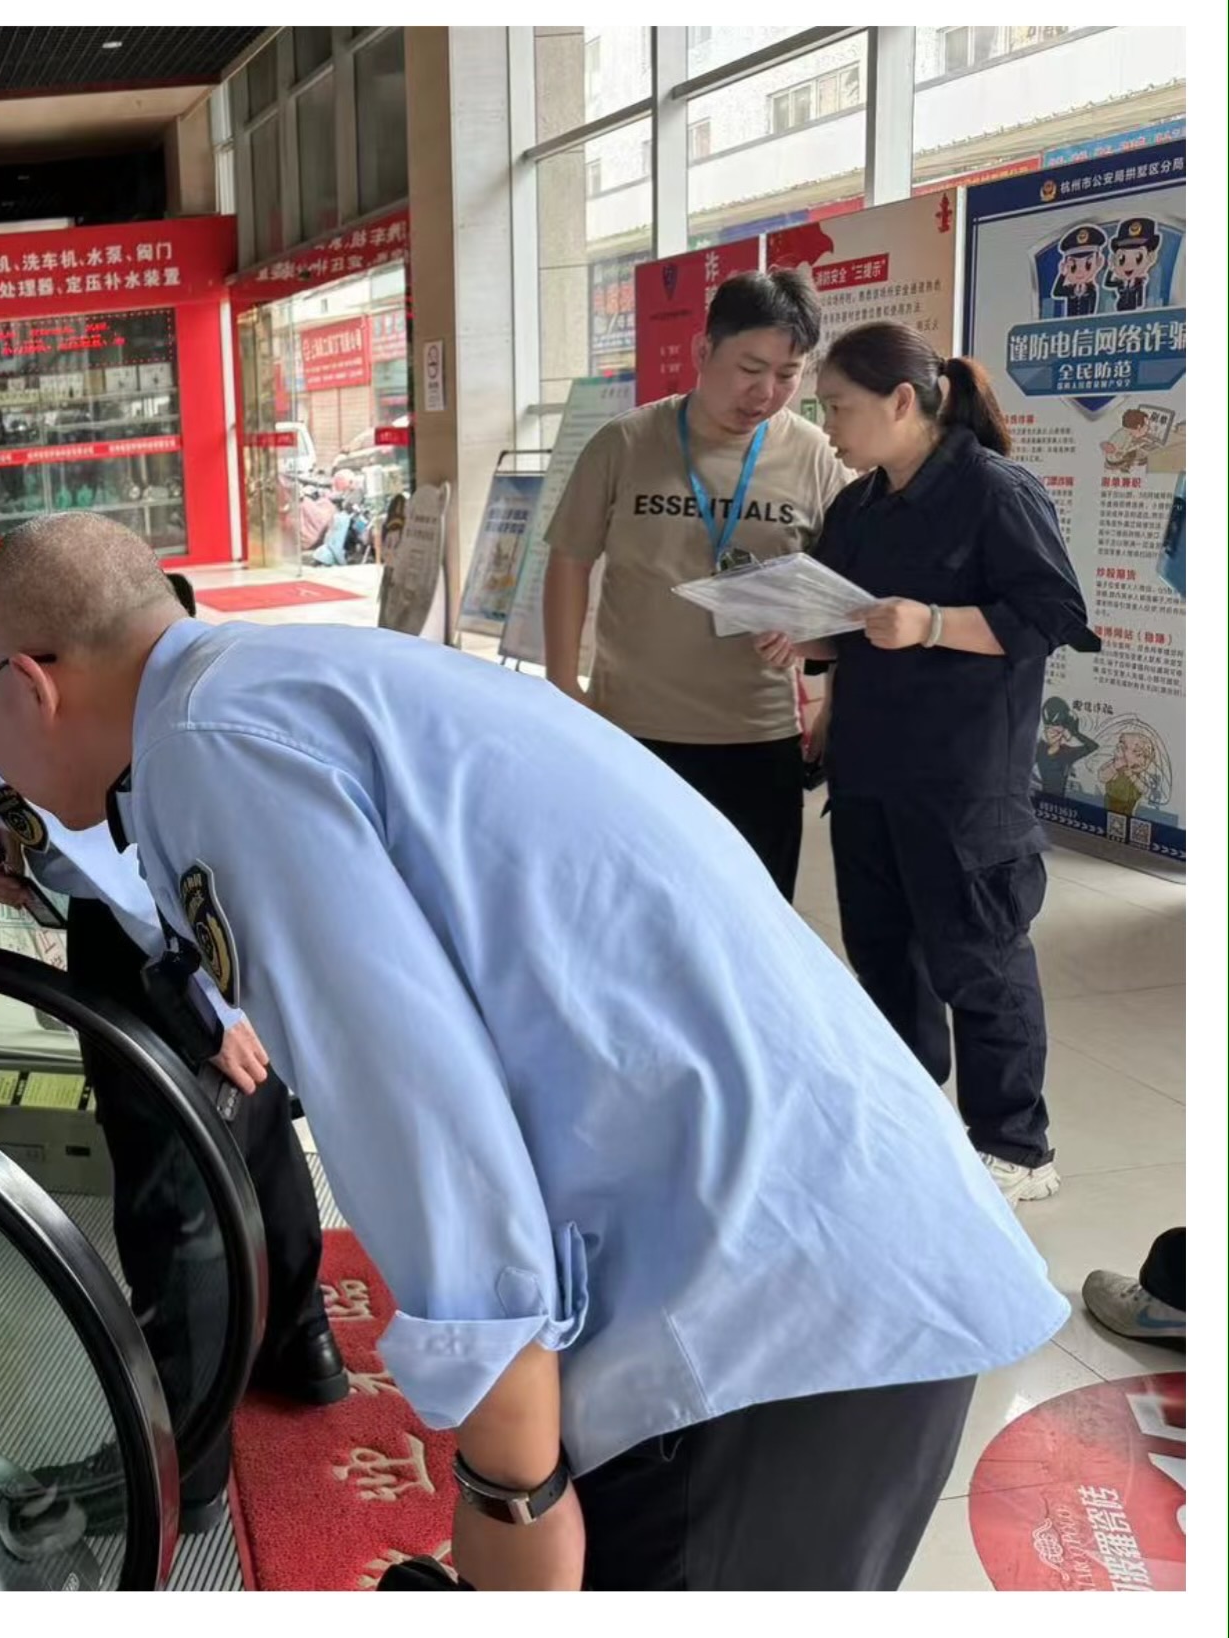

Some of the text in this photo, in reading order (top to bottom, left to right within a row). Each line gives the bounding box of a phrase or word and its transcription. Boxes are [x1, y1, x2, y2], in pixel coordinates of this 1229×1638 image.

[1060, 156, 1185, 194] 杭州市公安局拱墅区分局
[1008, 320, 1187, 363] 谨防电信网络诈骗
[1057, 361, 1133, 381] 全民防范
